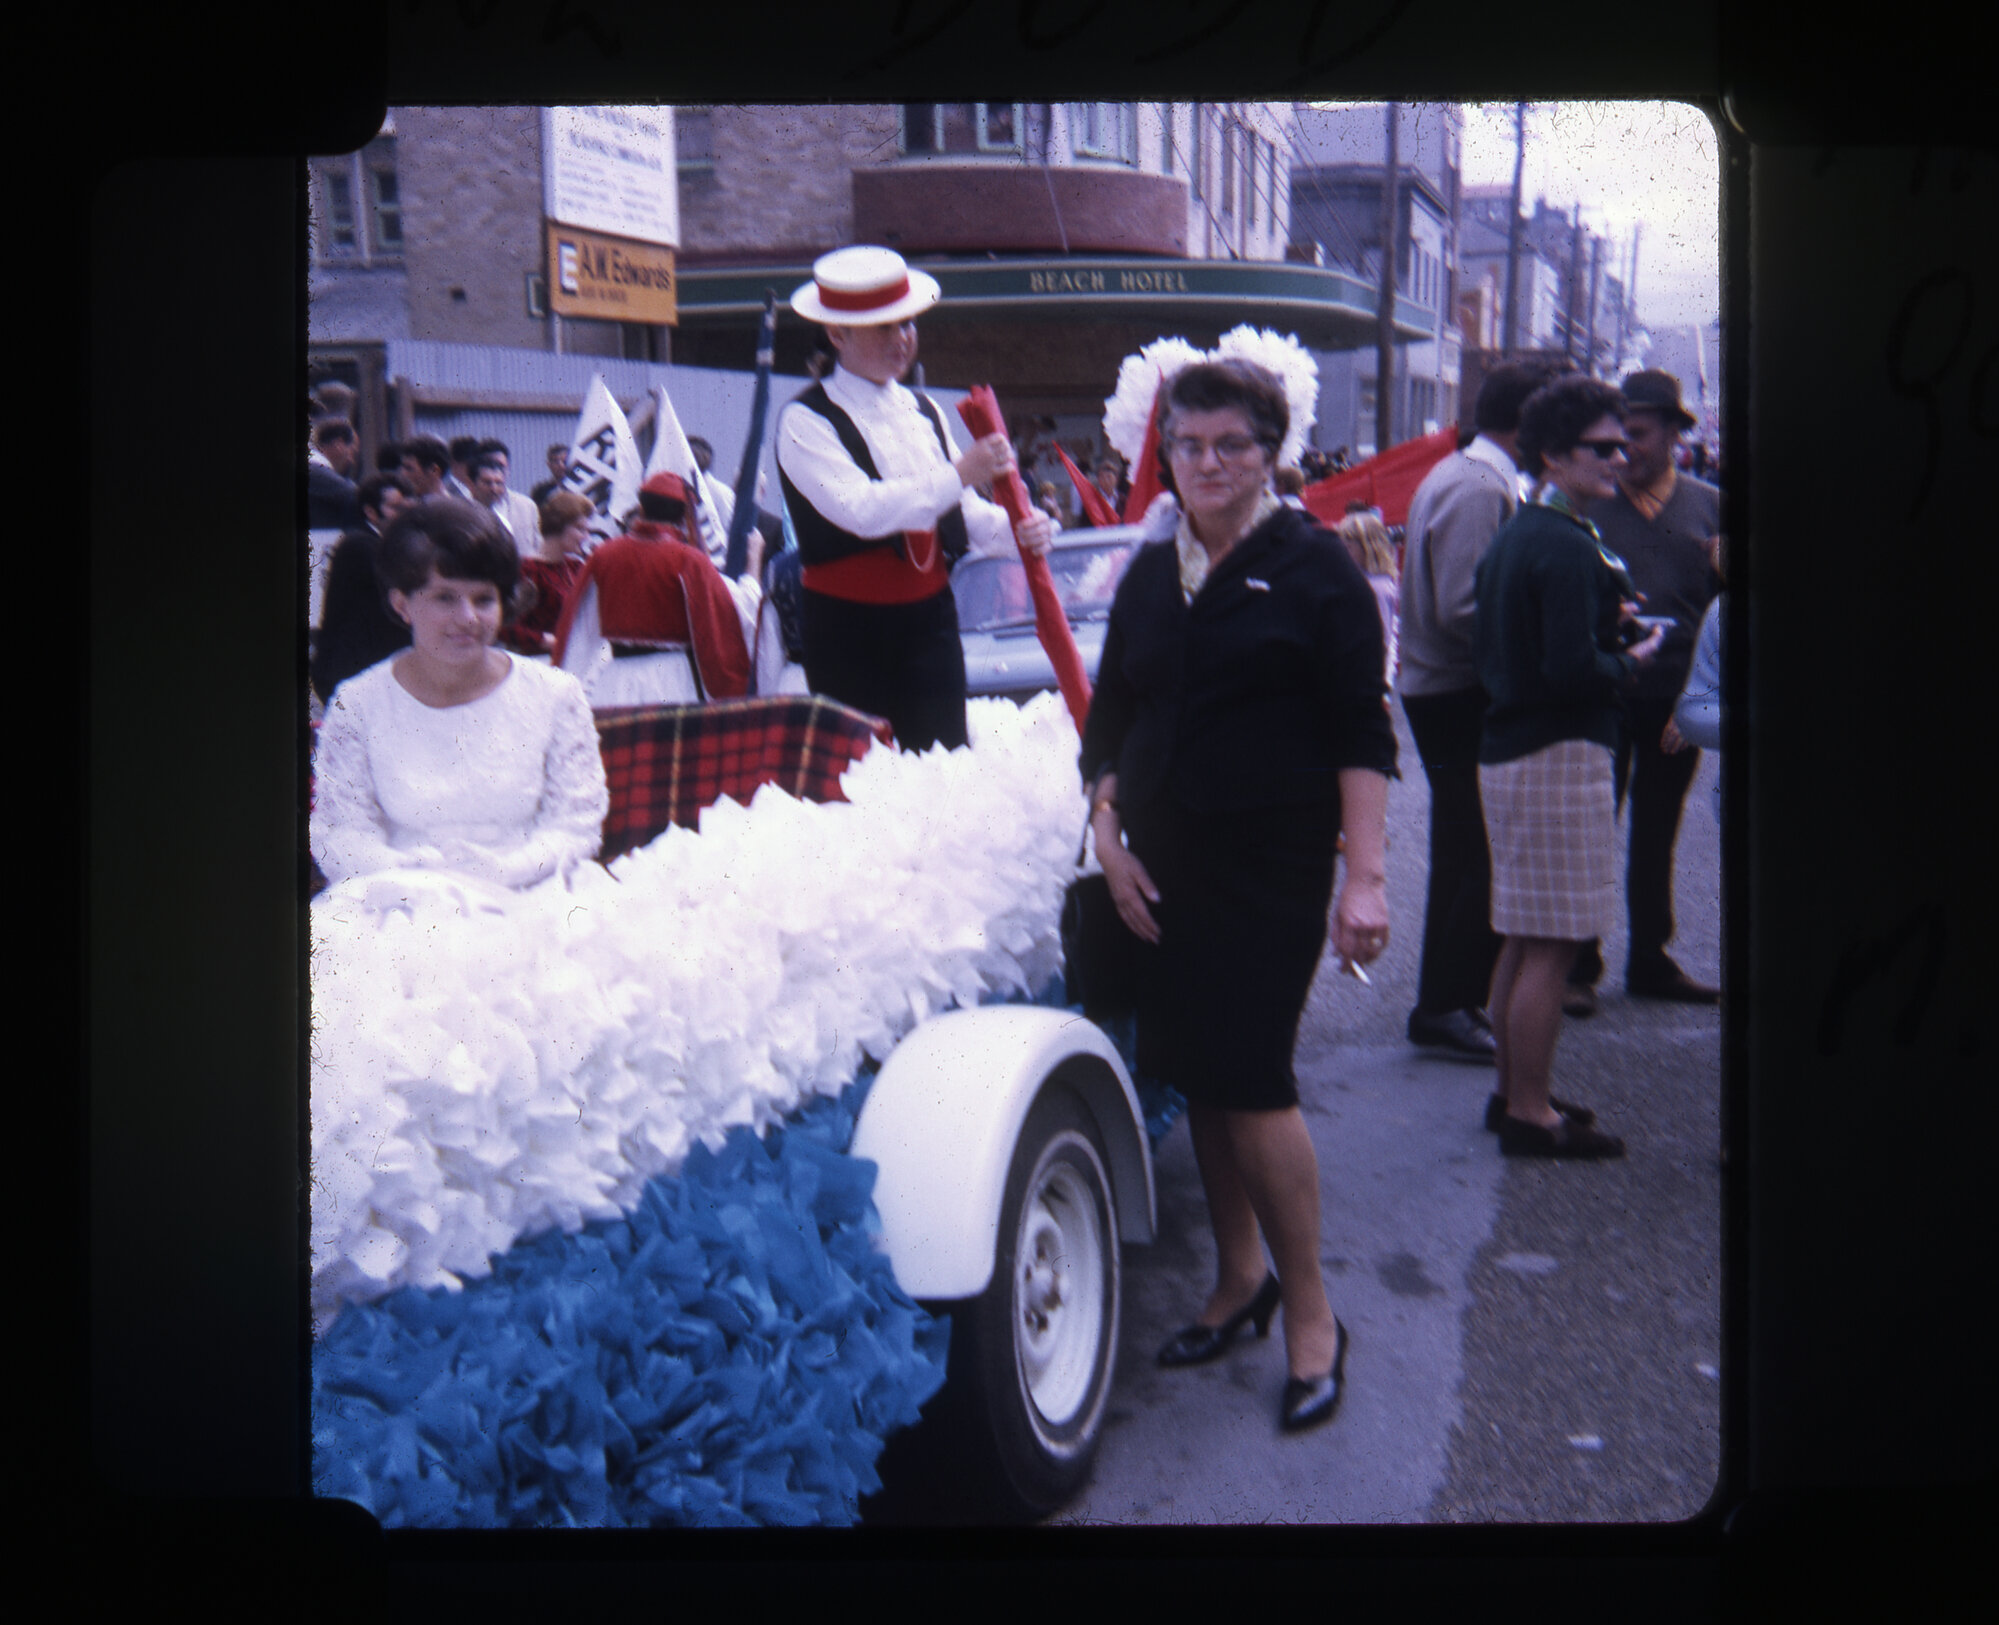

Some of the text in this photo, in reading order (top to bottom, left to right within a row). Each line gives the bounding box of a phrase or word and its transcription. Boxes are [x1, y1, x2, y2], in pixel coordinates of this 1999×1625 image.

[559, 241, 578, 296] E
[611, 246, 671, 291] Edwards
[1030, 271, 1188, 293] BEACH HOTEL
